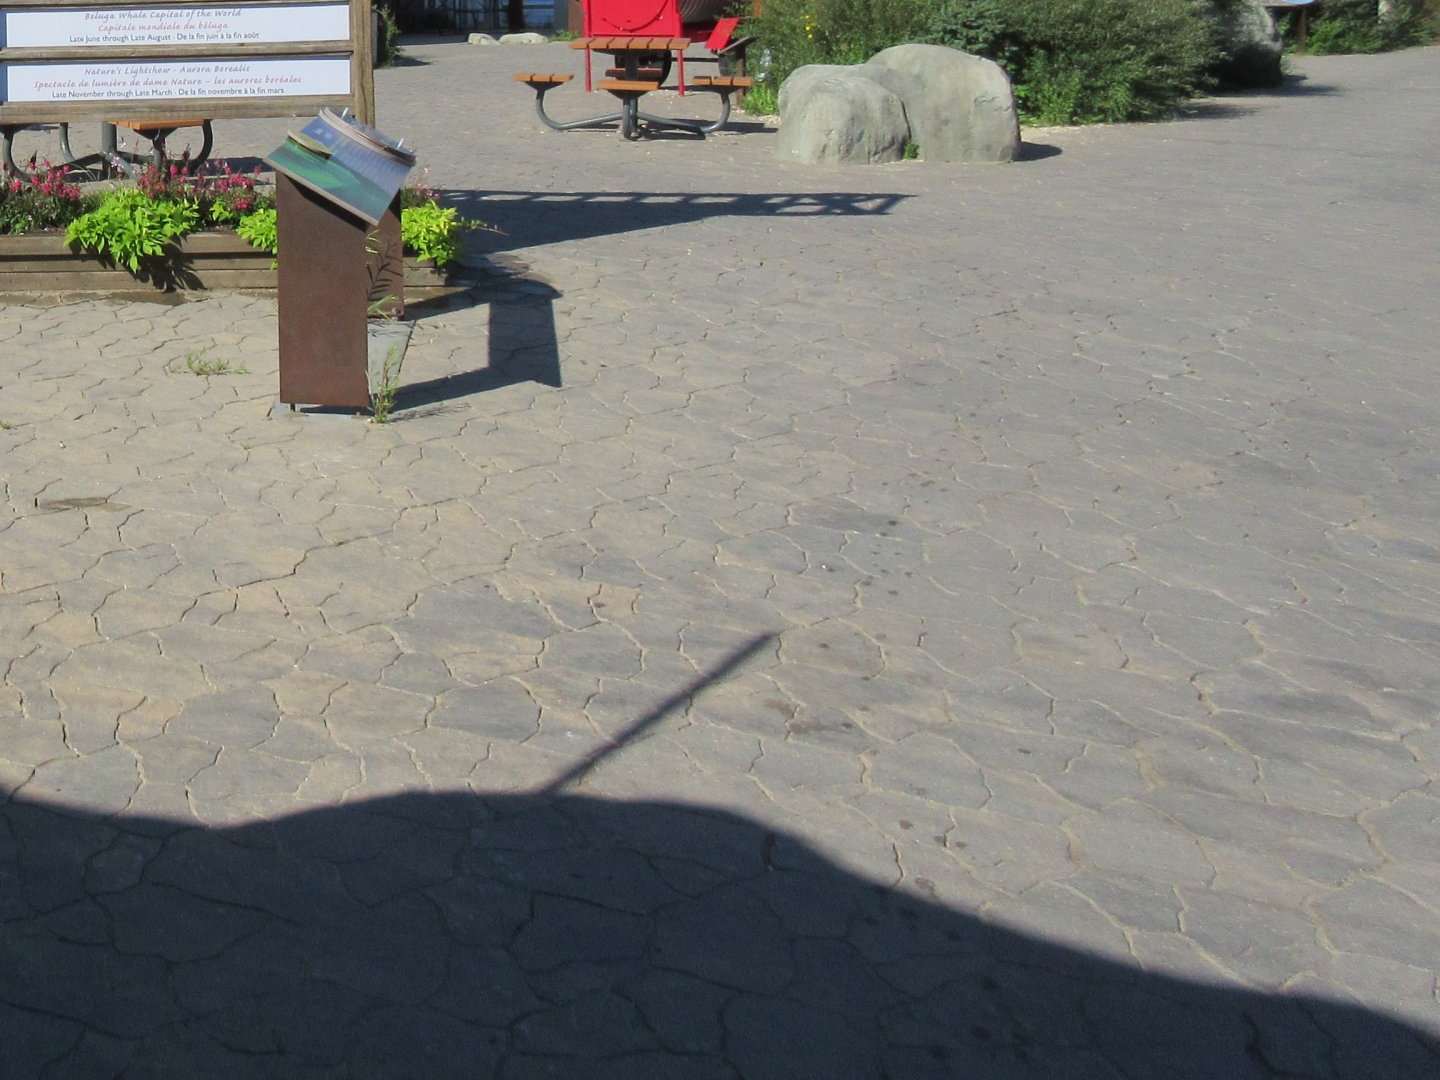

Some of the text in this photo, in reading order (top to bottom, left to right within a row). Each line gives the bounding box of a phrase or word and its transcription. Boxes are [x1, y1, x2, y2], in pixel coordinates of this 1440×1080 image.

[84, 8, 242, 23] Beluga Whale Capital of the World
[98, 23, 136, 34] Capitale
[138, 22, 180, 30] mondiale
[183, 21, 195, 30] du
[70, 35, 84, 43] Late
[85, 35, 100, 43] June
[102, 34, 128, 42] through
[147, 34, 171, 42] August
[196, 32, 205, 40] fin
[206, 33, 219, 41] juin
[125, 65, 170, 78] Lightshow
[106, 90, 134, 98] through
